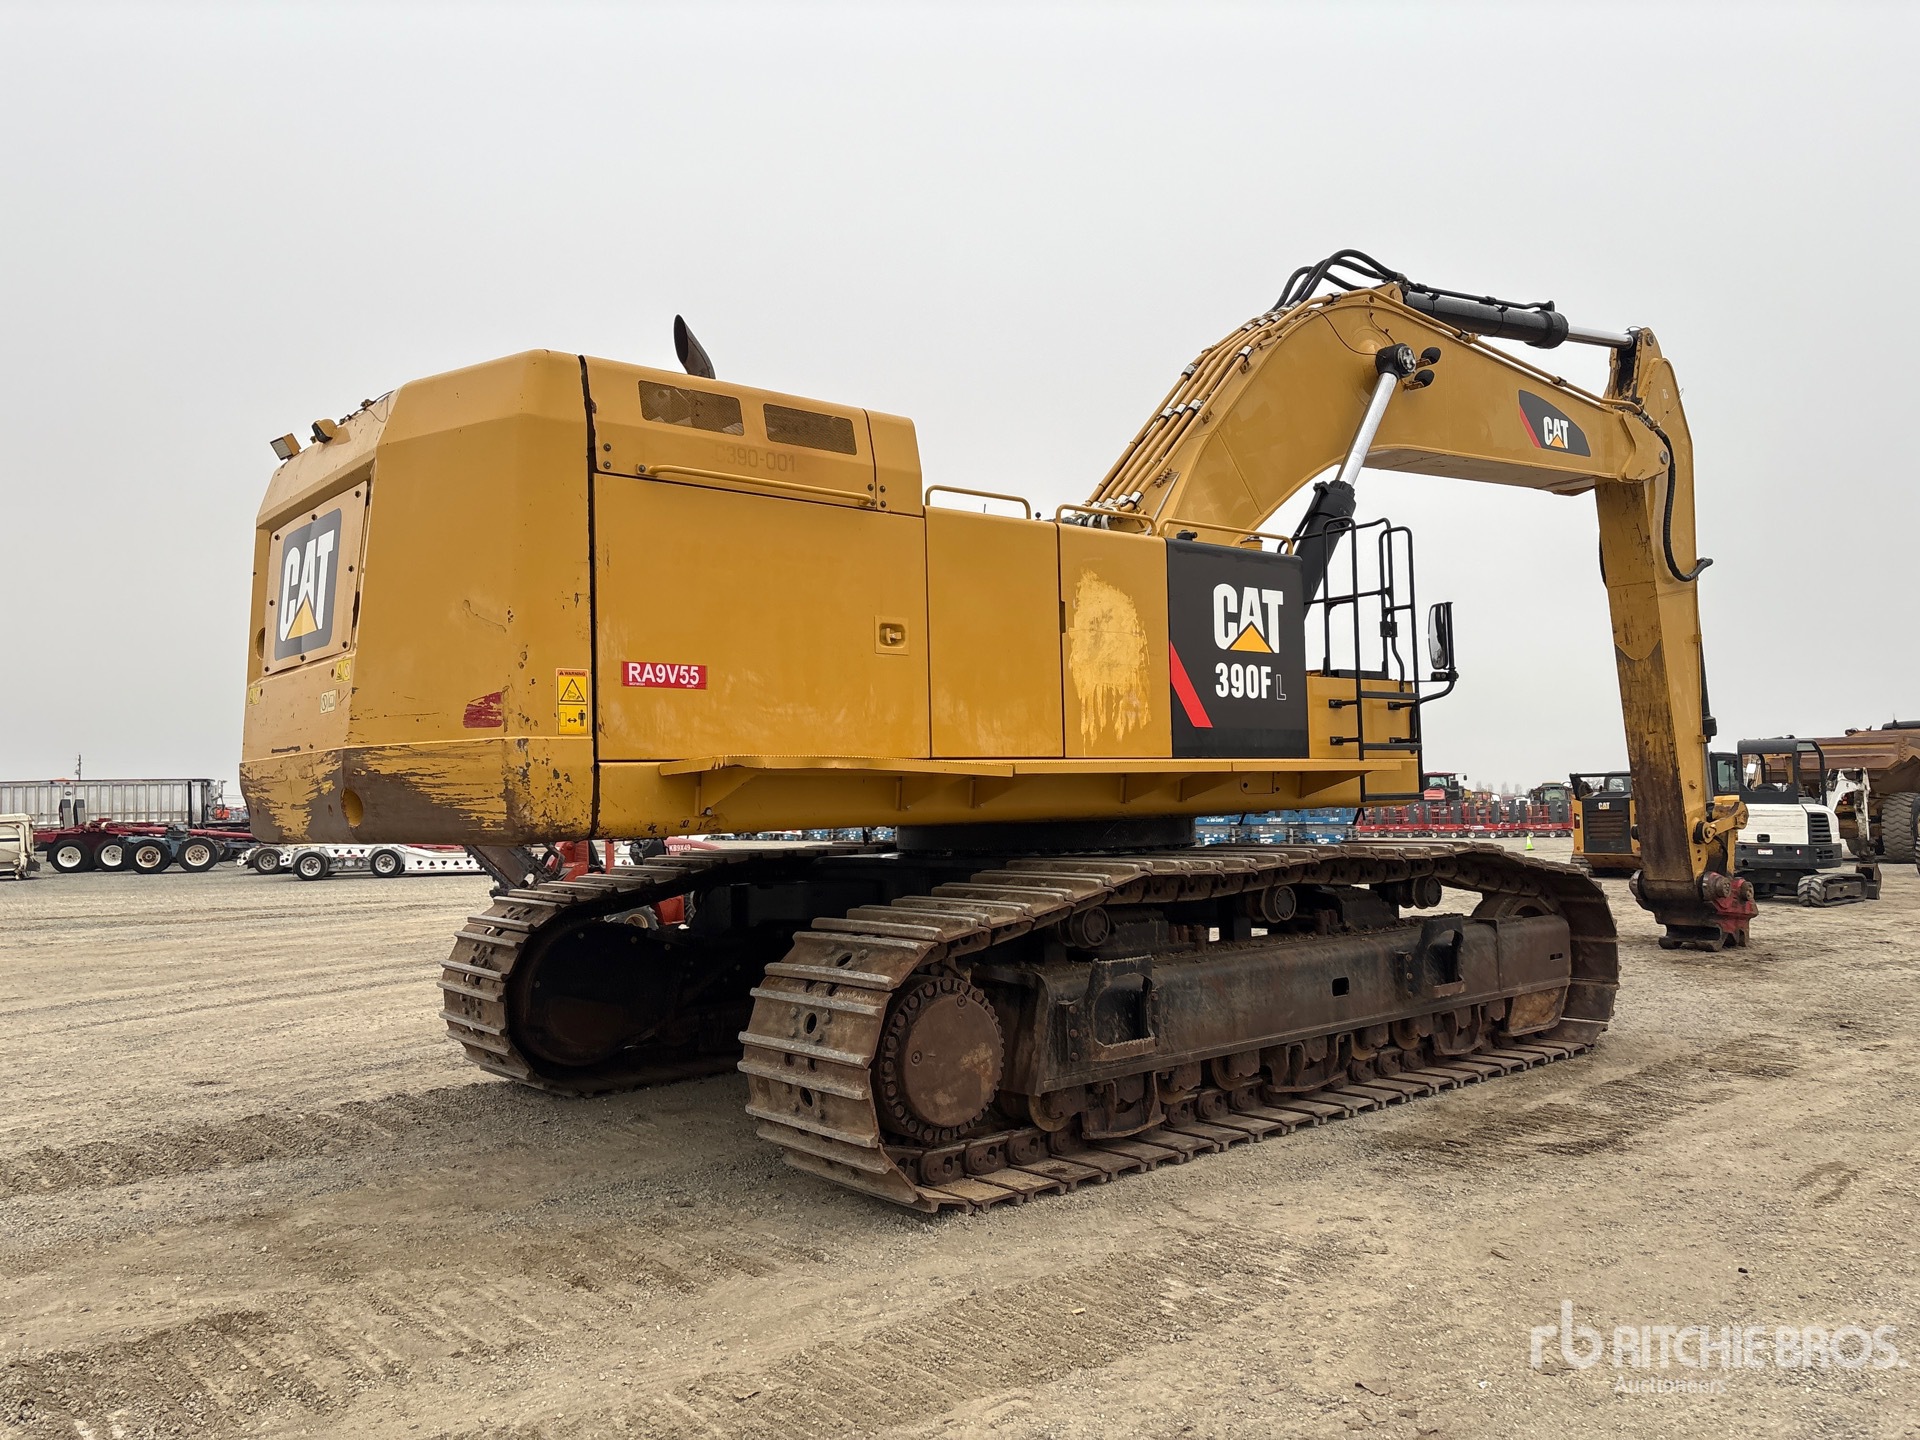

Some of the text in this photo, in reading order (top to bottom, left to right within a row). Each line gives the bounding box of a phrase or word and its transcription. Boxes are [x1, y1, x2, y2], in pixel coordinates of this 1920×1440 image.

[1543, 416, 1569, 449] CAT
[279, 529, 335, 642] CAT
[1213, 583, 1284, 653] CAT
[628, 662, 699, 685] RA9V55
[1215, 662, 1287, 700] 390F L
[1598, 802, 1610, 810] CAT
